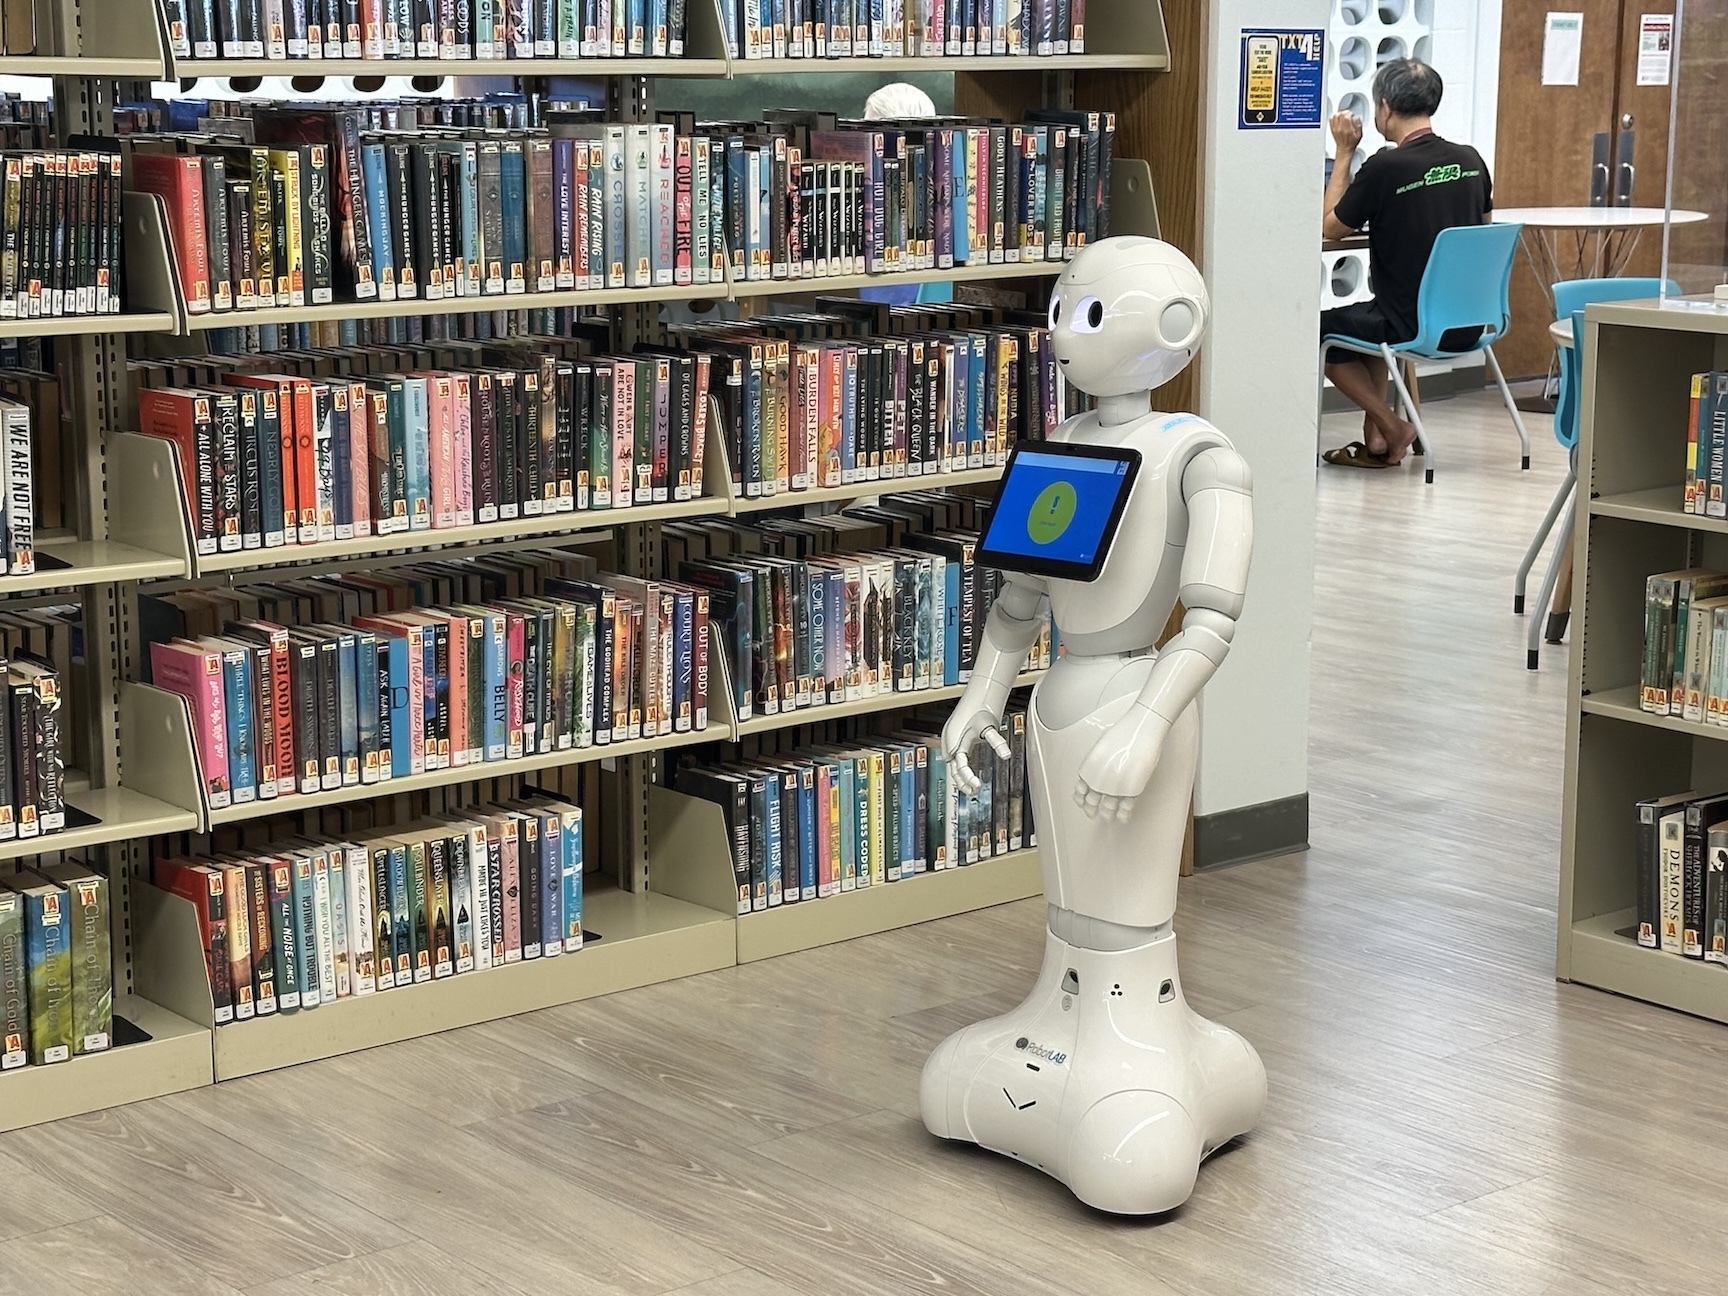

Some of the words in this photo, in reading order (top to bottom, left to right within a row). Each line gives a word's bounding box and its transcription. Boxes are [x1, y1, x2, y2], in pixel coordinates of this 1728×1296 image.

[1280, 34, 1304, 49] TXT
[997, 136, 1005, 162] GODLY
[677, 166, 691, 194] OUT
[698, 159, 707, 181] TELL
[1054, 169, 1063, 196] BRIGHT
[349, 168, 363, 218] HUNGER
[561, 186, 569, 209] LOVE
[578, 183, 588, 210] RAIN
[591, 187, 602, 218] RAIN
[699, 190, 707, 206] ME
[953, 177, 964, 197] E
[996, 166, 1005, 212] HEATHENS
[1028, 173, 1036, 207] LOVER
[699, 215, 707, 228] NO
[1054, 198, 1062, 216] RED
[241, 210, 249, 249] ARTEMIS
[379, 190, 389, 257] MOCKINGJAY
[561, 210, 570, 256] INTEREST
[591, 220, 602, 256] RISING
[677, 220, 691, 255] FIRE
[6, 232, 14, 249] THE
[355, 219, 366, 262] GAMES
[579, 212, 589, 270] REMEMBERS
[699, 236, 707, 258] LIES
[5, 276, 14, 296] EYES
[809, 374, 817, 424] BURDEN
[1000, 372, 1008, 396] WINGS
[618, 408, 624, 418] IN
[910, 387, 922, 420] BLACK
[929, 411, 936, 420] IN
[10, 425, 28, 446] WE
[223, 407, 234, 461] RECLAIM
[767, 397, 775, 445] BURNING
[884, 401, 894, 446] BITTER
[999, 418, 1007, 437] WILD
[1712, 411, 1726, 445] LITTLE
[198, 433, 210, 451] ALL
[266, 431, 279, 481] NEARLY
[808, 425, 816, 463] FALLS
[911, 424, 922, 460] QUEEN
[11, 450, 29, 478] ARE
[199, 452, 212, 483] ALONE
[1711, 447, 1725, 481] WOMEN
[12, 482, 31, 514] NOT
[201, 485, 213, 511] WITH
[225, 474, 236, 509] STARS
[442, 487, 451, 510] GIRL
[14, 516, 31, 551] FREE
[202, 511, 214, 535] YOU
[963, 563, 974, 572] A
[812, 583, 823, 609] SOME
[963, 575, 974, 623] TEMPEST
[680, 603, 692, 640] COURT
[903, 595, 912, 633] BLACK
[698, 626, 708, 649] OUT
[962, 626, 973, 637] OF
[604, 646, 612, 683] GODHEAD
[700, 652, 707, 662] OF
[962, 641, 973, 664] TEA
[276, 657, 290, 718] BLOOD
[327, 679, 335, 711] DEATH
[379, 670, 388, 689] ASK
[698, 665, 708, 697] BODY
[237, 690, 246, 724] THINGS
[391, 686, 409, 709] D
[494, 685, 505, 723] BELLY
[602, 685, 610, 723] COMPLEX
[279, 723, 292, 777] MOON
[770, 800, 781, 838] FLIGHT
[859, 802, 868, 837] DRESS
[771, 840, 781, 868] RISK
[860, 840, 869, 877] CODED
[414, 850, 425, 908] SOULBINDER
[432, 845, 444, 906] QUEENSLAYER
[478, 865, 486, 887] MAYBE
[489, 852, 500, 891] STAR
[1669, 850, 1680, 922] DEMONS
[254, 876, 264, 905] SISTERS
[1693, 859, 1702, 917] ADVENTURES
[282, 903, 290, 917] ALL
[302, 896, 312, 933] NOTHING
[335, 902, 345, 946] OASIS
[480, 915, 489, 935] LIKES
[491, 890, 502, 943] CROSSED
[84, 904, 99, 950] Chain
[256, 911, 268, 950] RECKONING
[283, 928, 294, 958] NOISE
[305, 935, 313, 951] BUT
[2, 933, 17, 974] Chain
[45, 927, 59, 972] Chain
[86, 954, 100, 970] of
[6, 976, 19, 996] of
[47, 976, 61, 993] of
[286, 964, 294, 985] ONCE
[306, 953, 318, 991] TROUBLE
[324, 965, 332, 984] BEST
[6, 999, 20, 1032] Gold
[1028, 1042, 1066, 1064] RobotLAB
